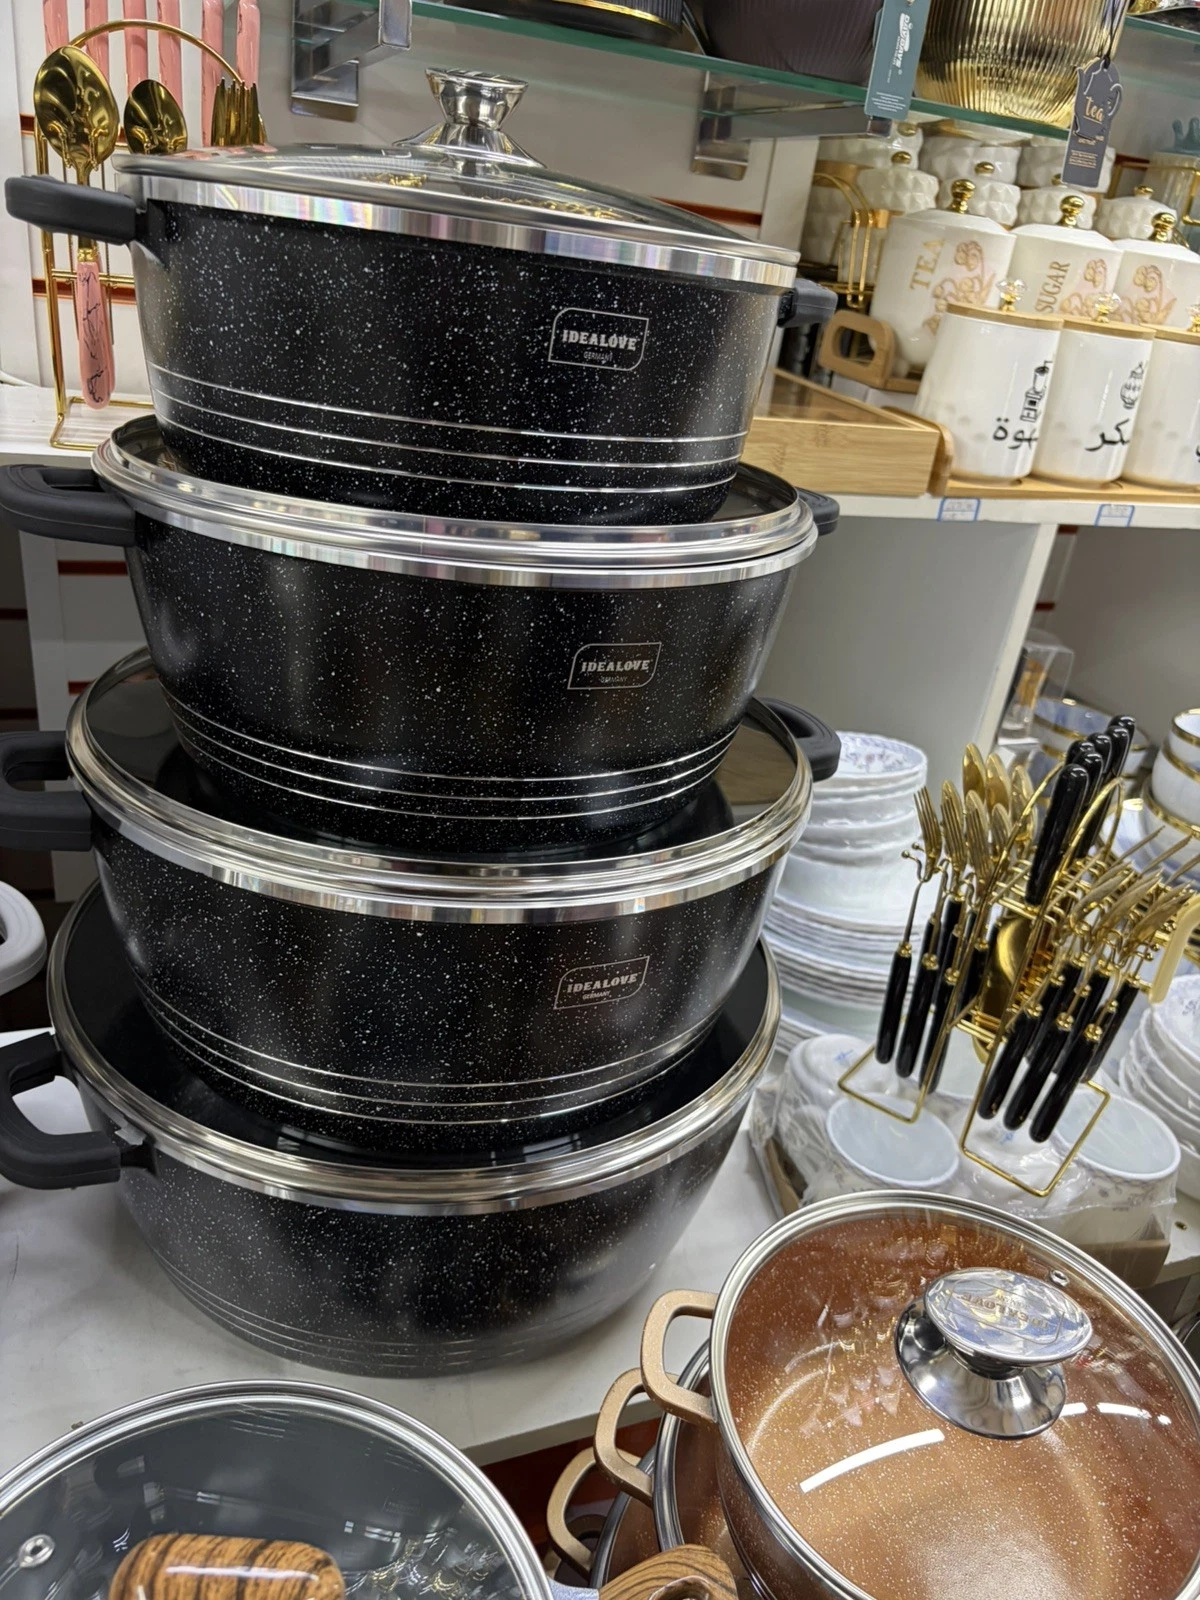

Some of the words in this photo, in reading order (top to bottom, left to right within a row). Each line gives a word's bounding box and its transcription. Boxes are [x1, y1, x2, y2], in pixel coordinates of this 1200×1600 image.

[1083, 95, 1105, 122] tea
[910, 238, 946, 290] TEA
[1034, 260, 1071, 313] SUGAR
[561, 329, 638, 351] IDEALOVE
[583, 351, 613, 362] GERMANY
[1085, 417, 1130, 452] كر
[580, 660, 650, 672] IDEALOVE
[567, 973, 638, 993] IDEALOVE
